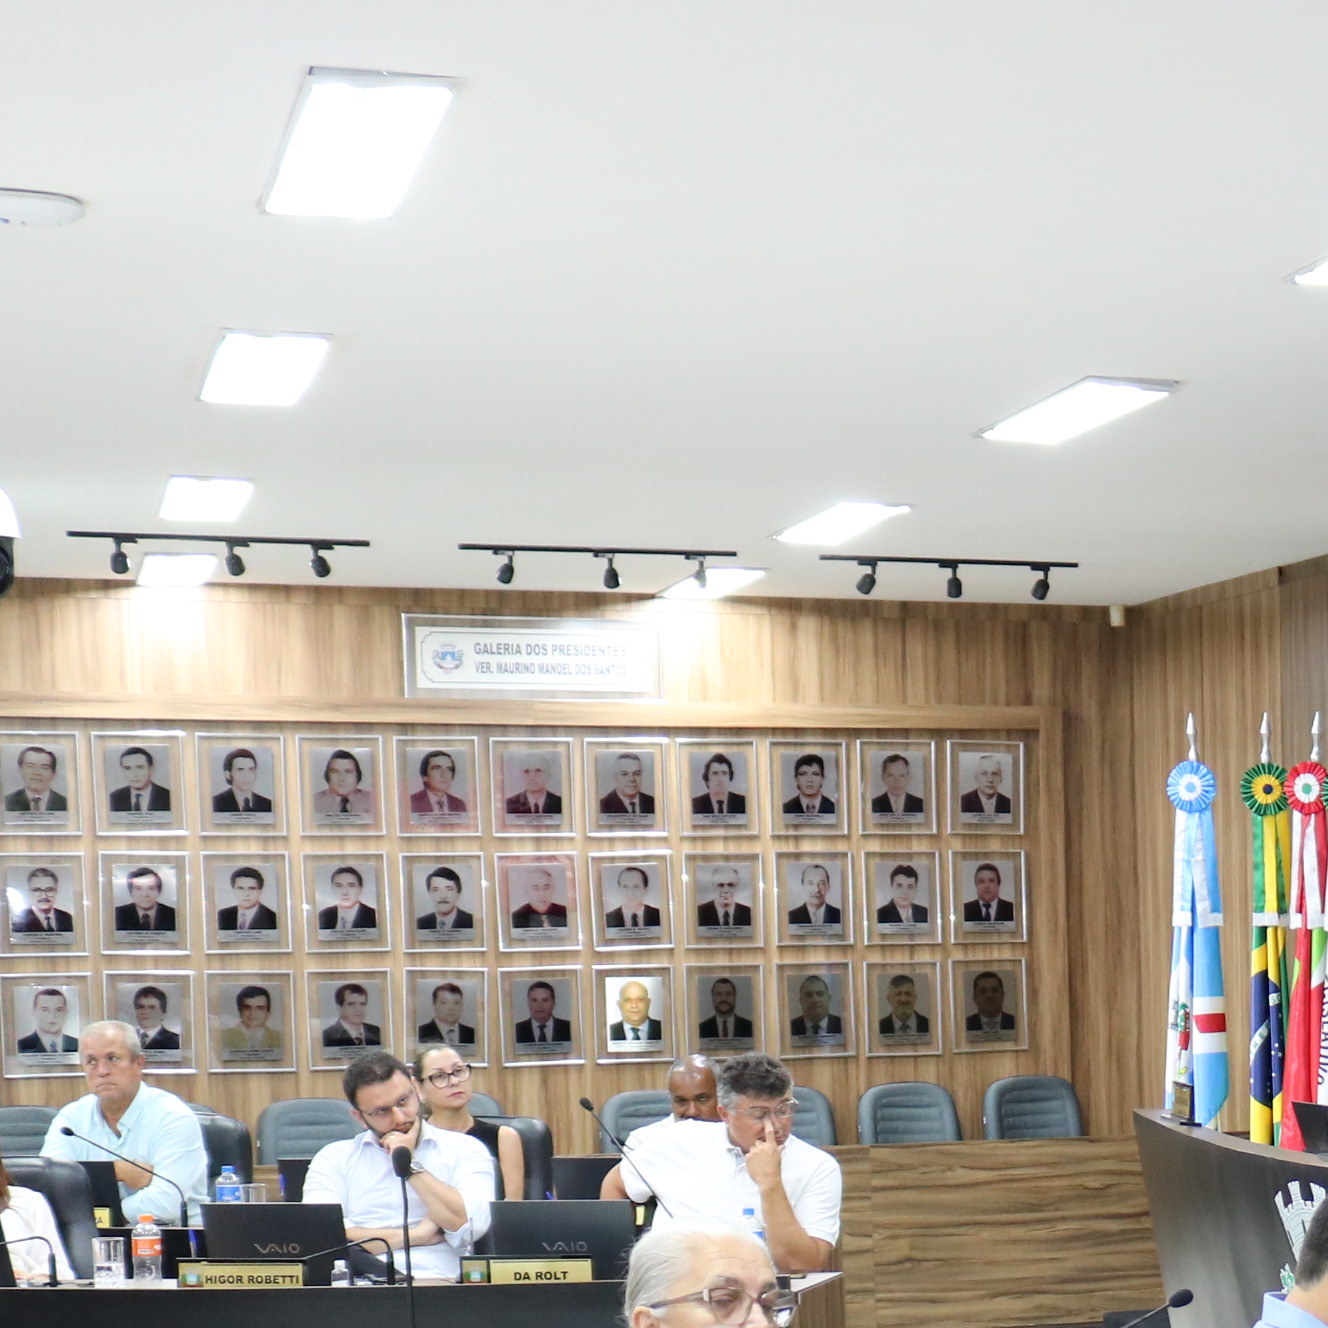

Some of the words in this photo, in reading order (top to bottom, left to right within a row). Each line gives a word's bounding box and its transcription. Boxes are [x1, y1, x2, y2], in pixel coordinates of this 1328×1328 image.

[473, 642, 522, 655] GALERIA
[525, 643, 548, 656] DOS
[474, 661, 494, 674] VER.
[496, 661, 536, 675] MAURINO
[538, 662, 572, 676] MANOEL
[253, 1243, 300, 1254] VAIO
[541, 1241, 588, 1252] VAIO
[205, 1275, 243, 1285] HIGOR
[247, 1274, 300, 1285] ROBETTI
[514, 1271, 531, 1282] DA
[535, 1271, 569, 1281] ROLT
